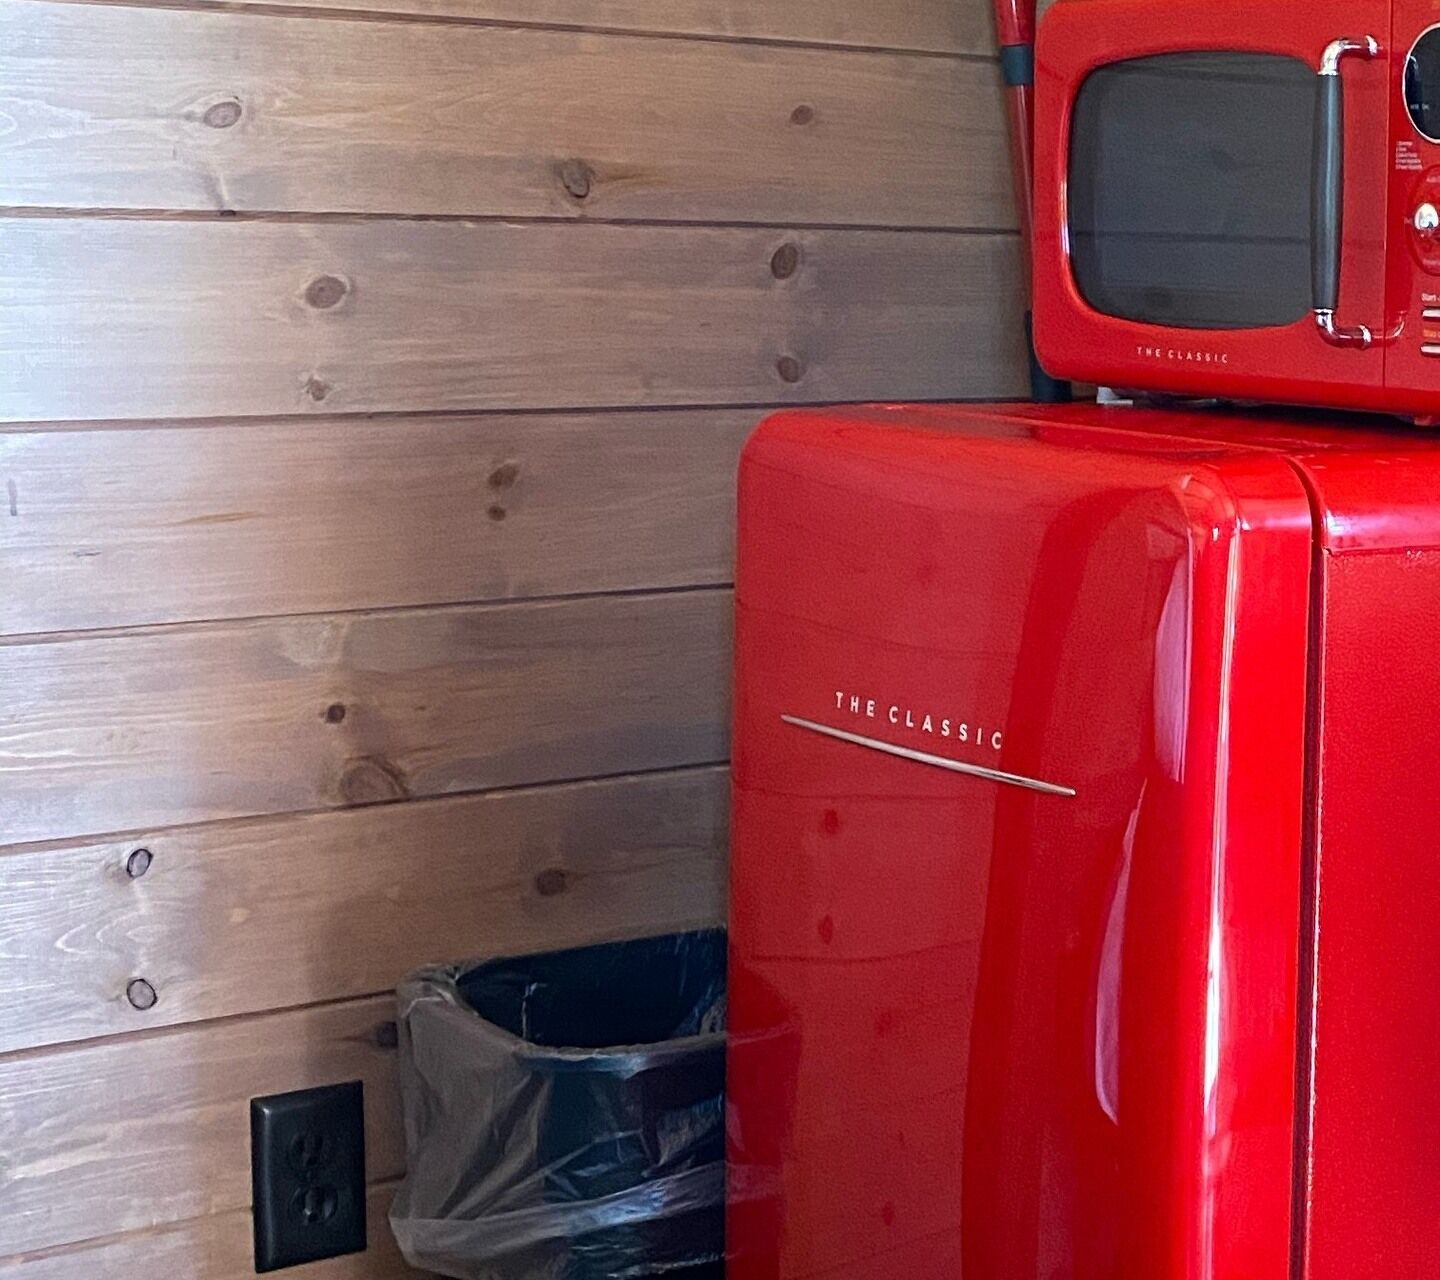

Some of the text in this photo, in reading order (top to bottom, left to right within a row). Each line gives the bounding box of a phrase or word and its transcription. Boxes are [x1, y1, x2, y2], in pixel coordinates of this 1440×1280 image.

[1137, 346, 1228, 364] THE CLASSIC
[835, 691, 1002, 750] THE CLASSIC
